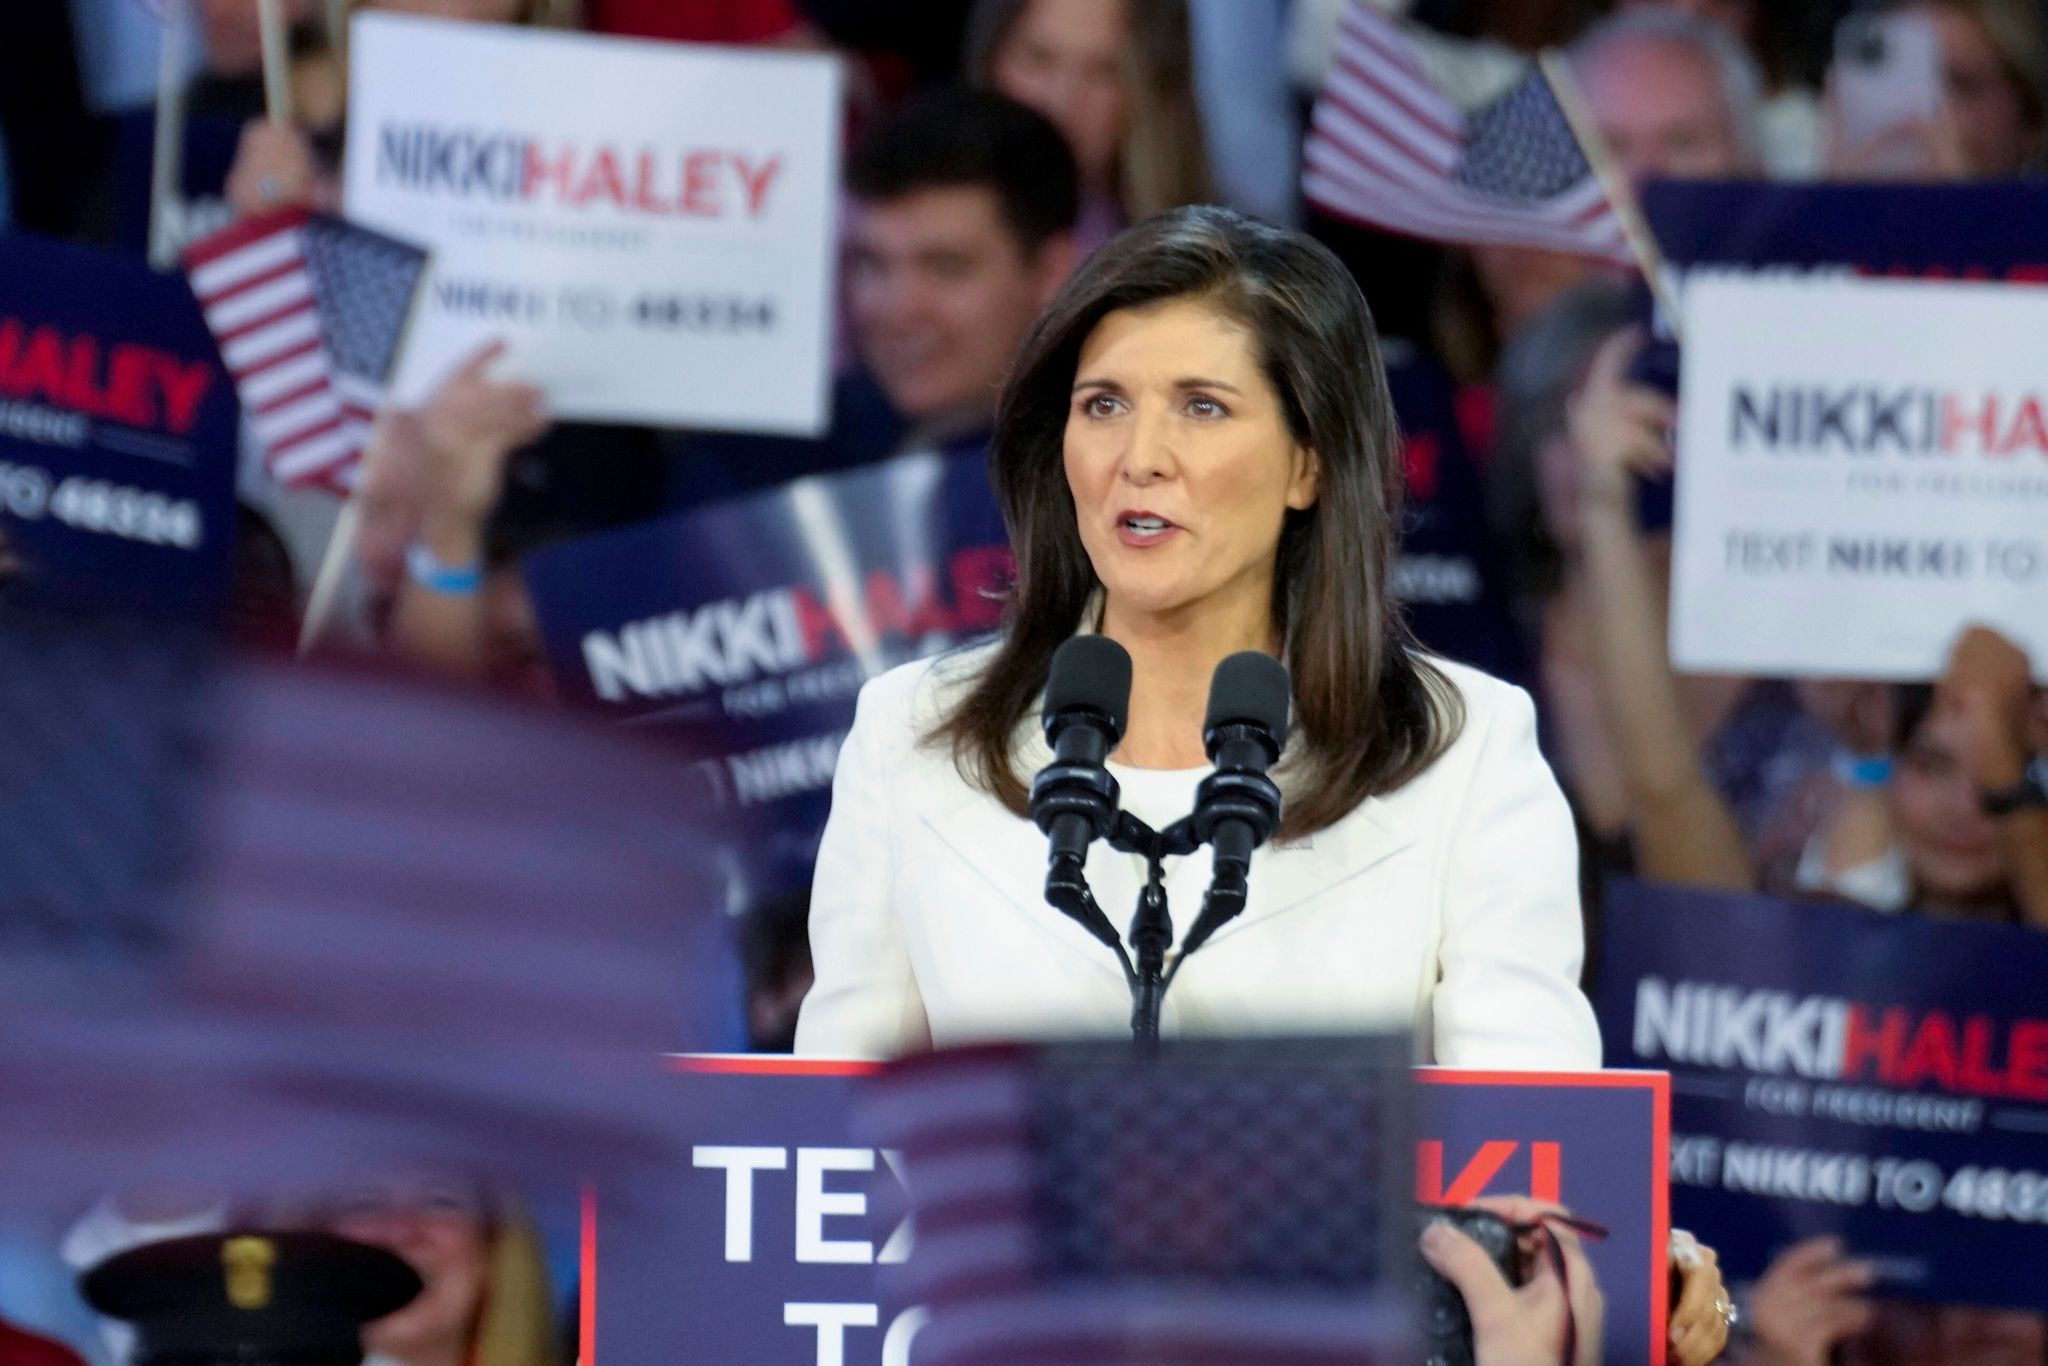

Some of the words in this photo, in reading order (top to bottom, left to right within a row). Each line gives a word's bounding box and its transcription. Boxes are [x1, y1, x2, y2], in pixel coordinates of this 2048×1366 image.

[1724, 530, 1815, 577] TEXT
[1826, 536, 1967, 580] NIKKI
[1985, 538, 2039, 583] TO
[1812, 1084, 1983, 1134] PRESIDENT
[1671, 1133, 1721, 1189] XT
[1722, 1141, 1872, 1206] NIKKI
[1873, 1158, 1945, 1213] TO
